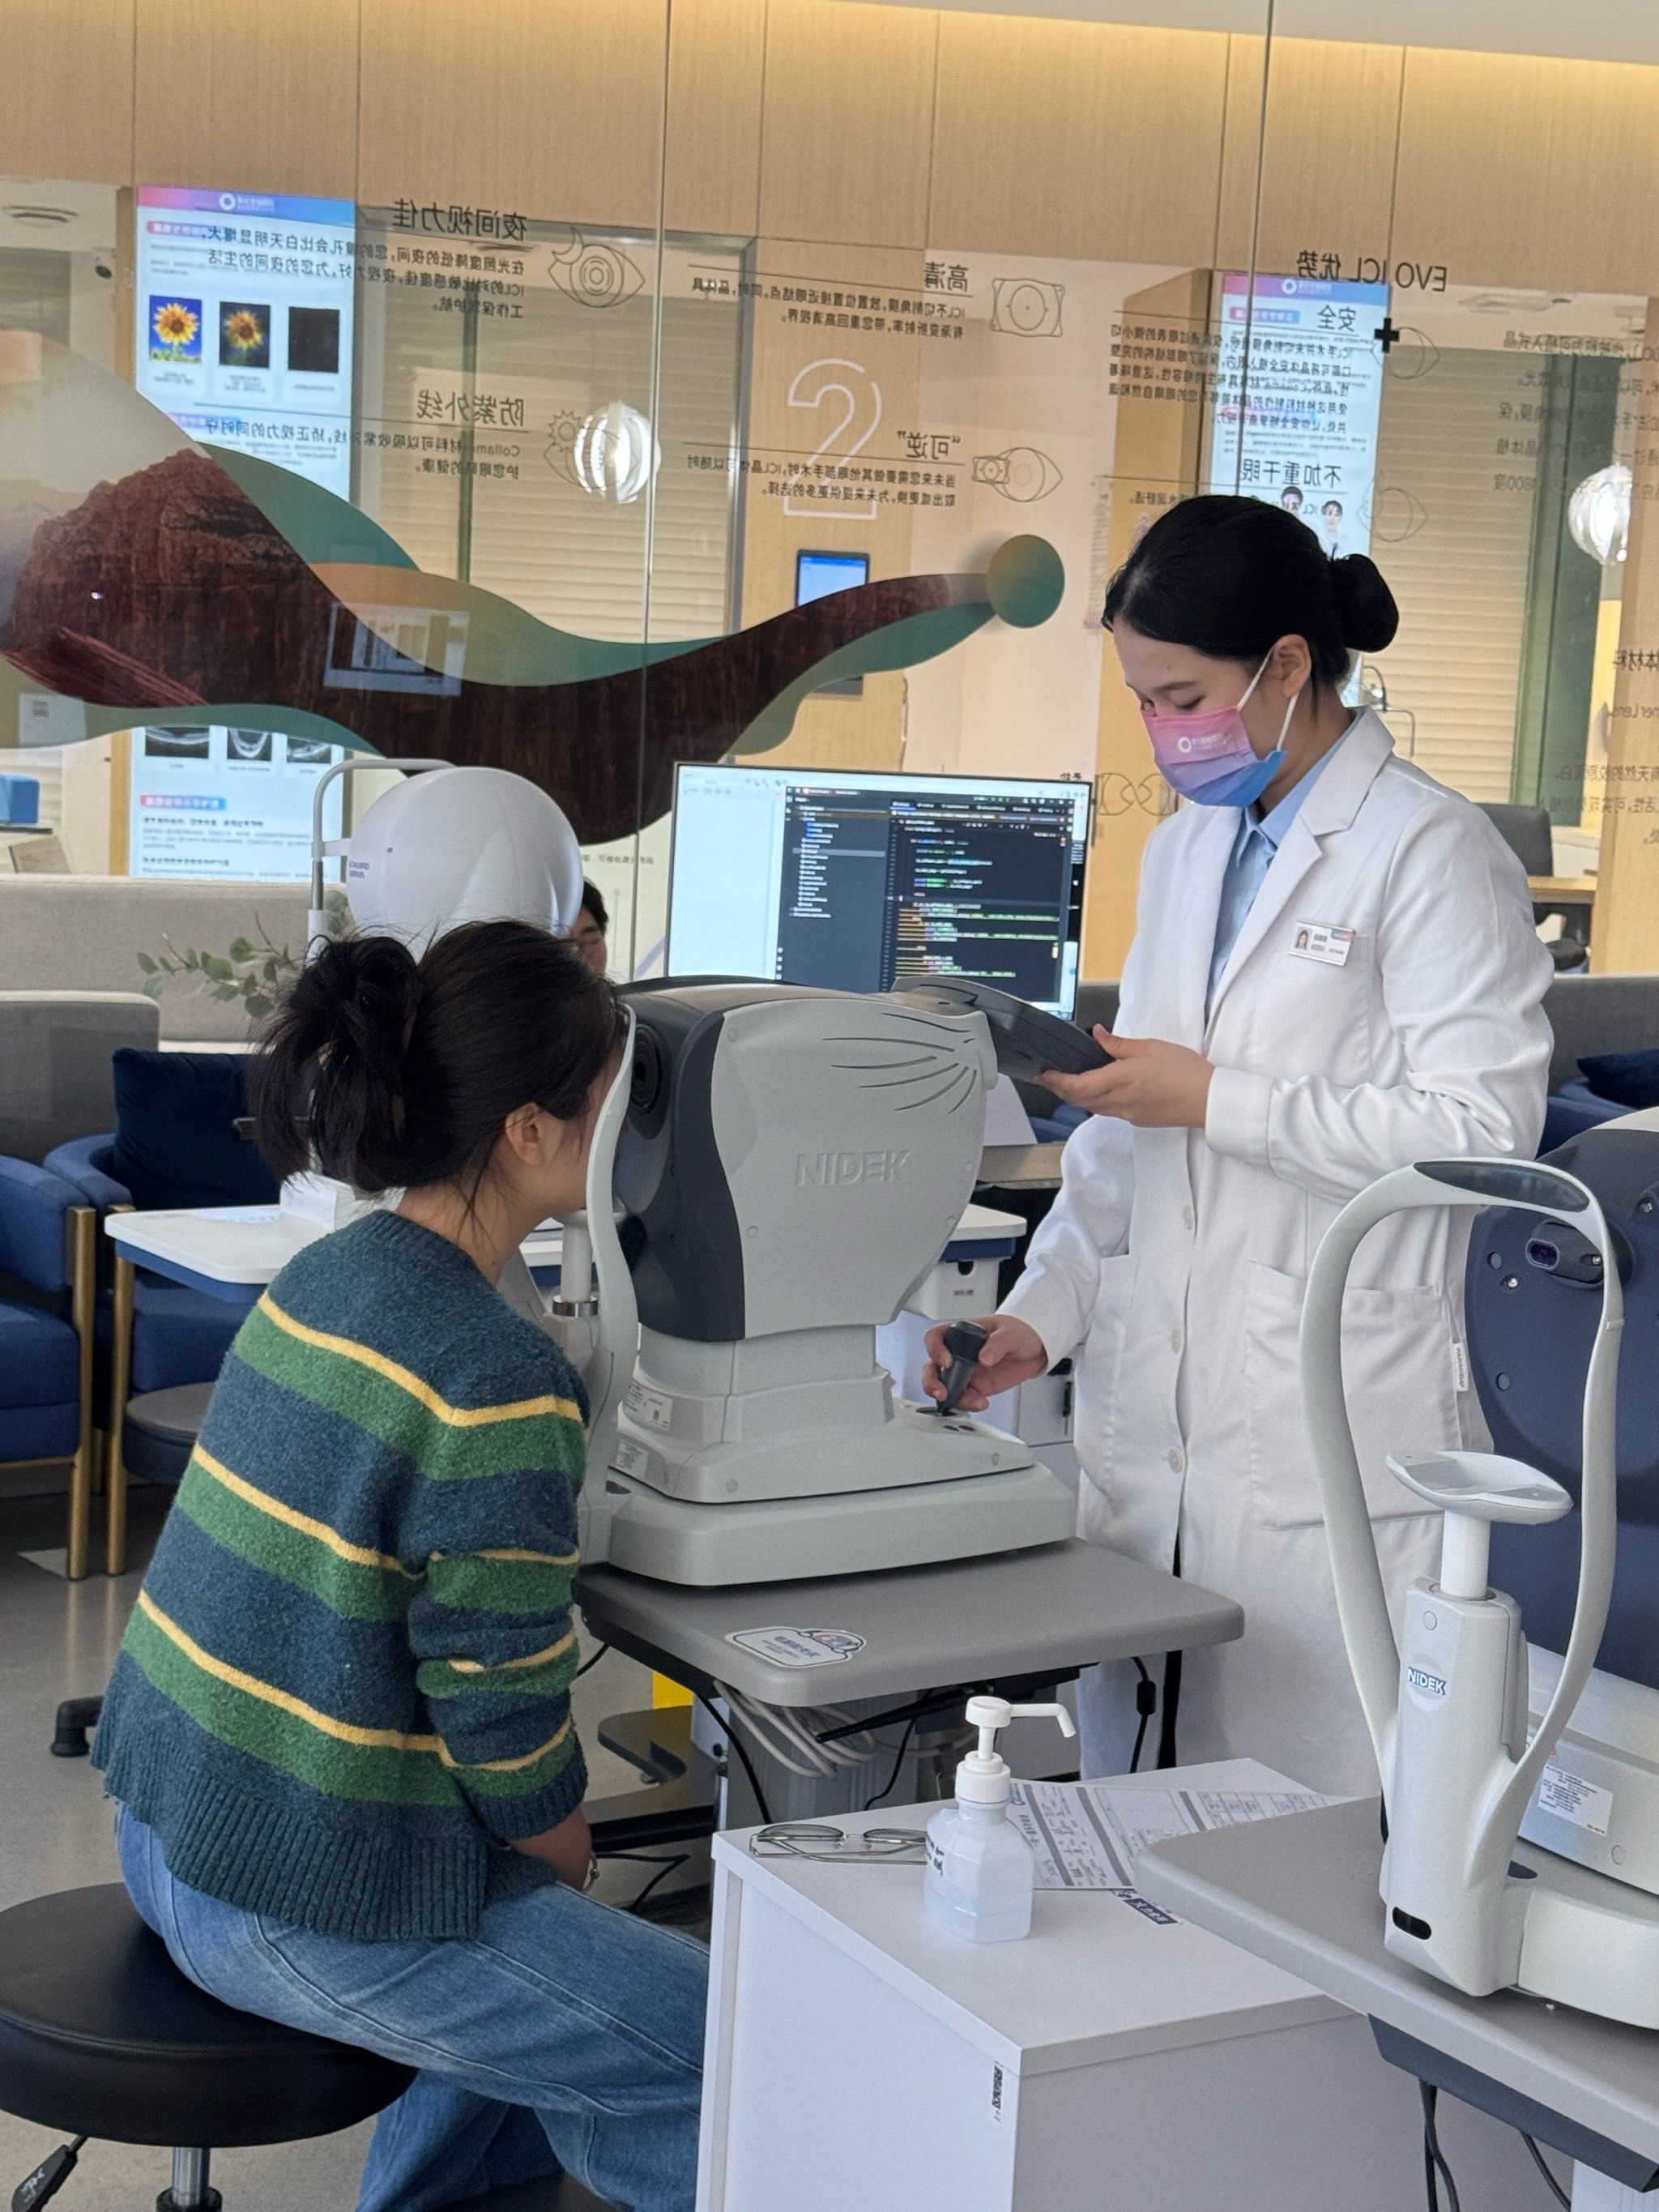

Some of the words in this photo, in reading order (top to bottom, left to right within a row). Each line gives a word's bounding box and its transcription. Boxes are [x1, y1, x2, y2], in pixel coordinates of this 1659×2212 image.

[783, 357, 883, 519] 2
[795, 1150, 911, 1186] NIDEK
[1407, 1666, 1446, 1695] NIDEK
